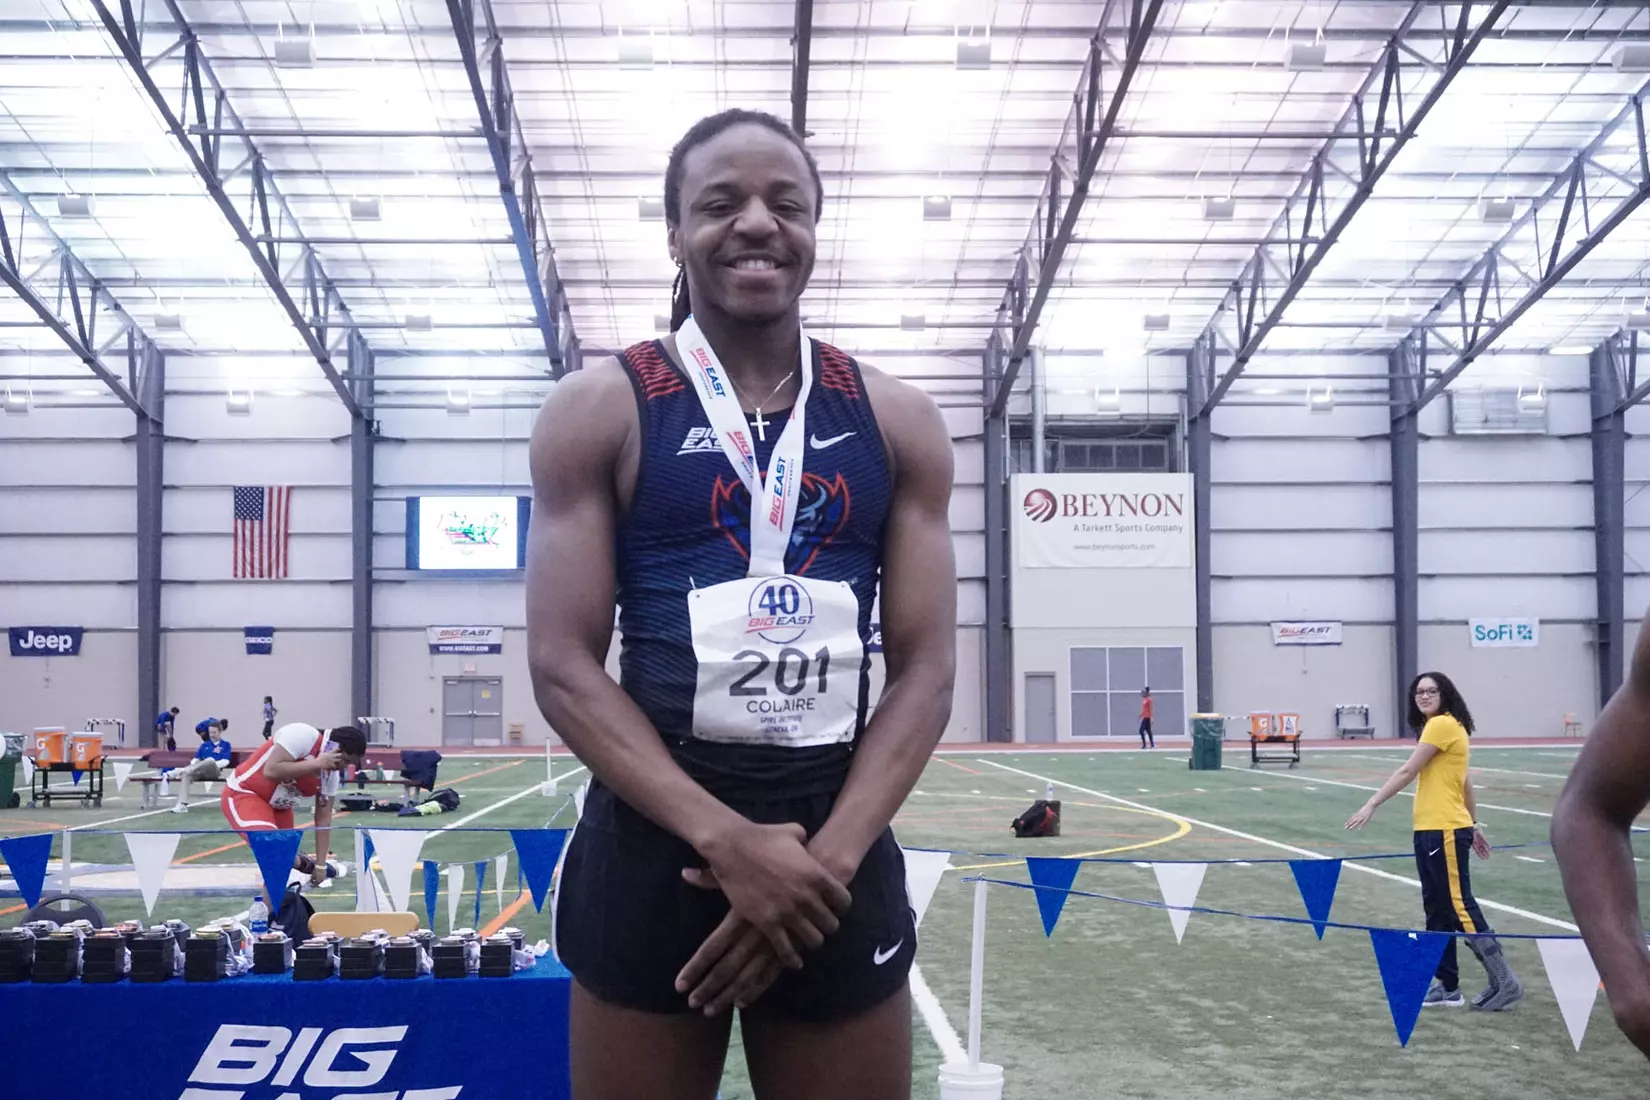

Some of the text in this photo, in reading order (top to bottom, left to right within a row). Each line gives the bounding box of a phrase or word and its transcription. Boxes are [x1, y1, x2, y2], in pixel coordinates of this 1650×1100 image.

[695, 347, 712, 367] BIG
[706, 367, 726, 397] EAST
[681, 438, 722, 449] EA
[769, 456, 786, 526] BIG EAST
[1061, 493, 1184, 517] BEYNON
[1073, 523, 1184, 533] A Tarkett Sports Company
[1073, 543, 1156, 551] www.beynonsports.com
[759, 584, 800, 616] 40
[748, 615, 815, 627] BIG EAST
[19, 630, 73, 652] Jeep
[460, 629, 493, 637] EAST
[1475, 624, 1513, 641] SoFi
[729, 645, 830, 696] 201
[746, 697, 816, 713] COLAIRE
[187, 1023, 409, 1087] BIG
